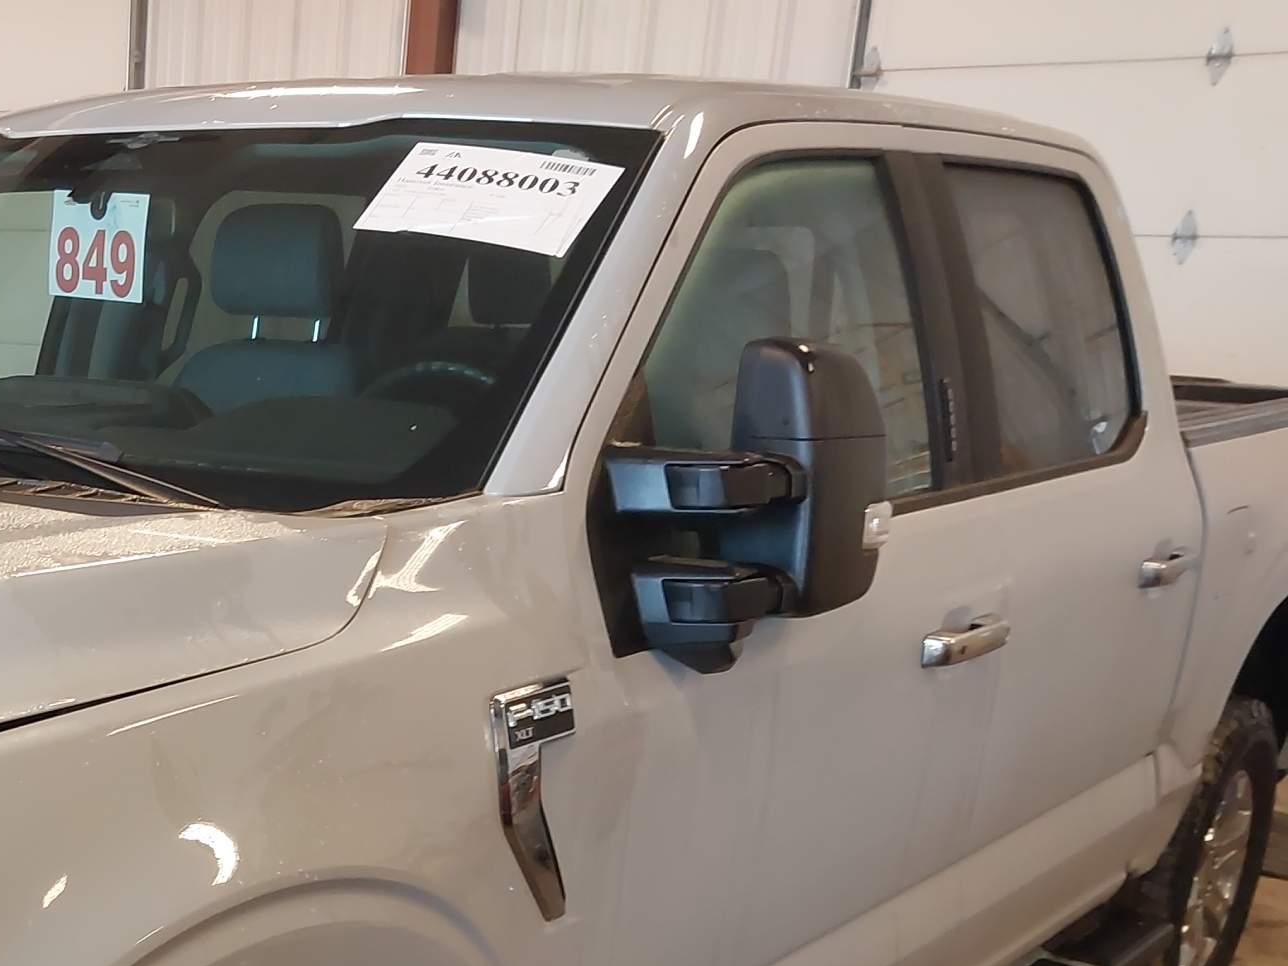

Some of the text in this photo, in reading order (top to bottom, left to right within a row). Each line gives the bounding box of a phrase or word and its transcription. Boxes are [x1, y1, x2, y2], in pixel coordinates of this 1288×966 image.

[416, 162, 579, 197] 44088003
[56, 227, 135, 298] 849
[507, 694, 572, 727] F-150
[515, 727, 534, 741] XLT
